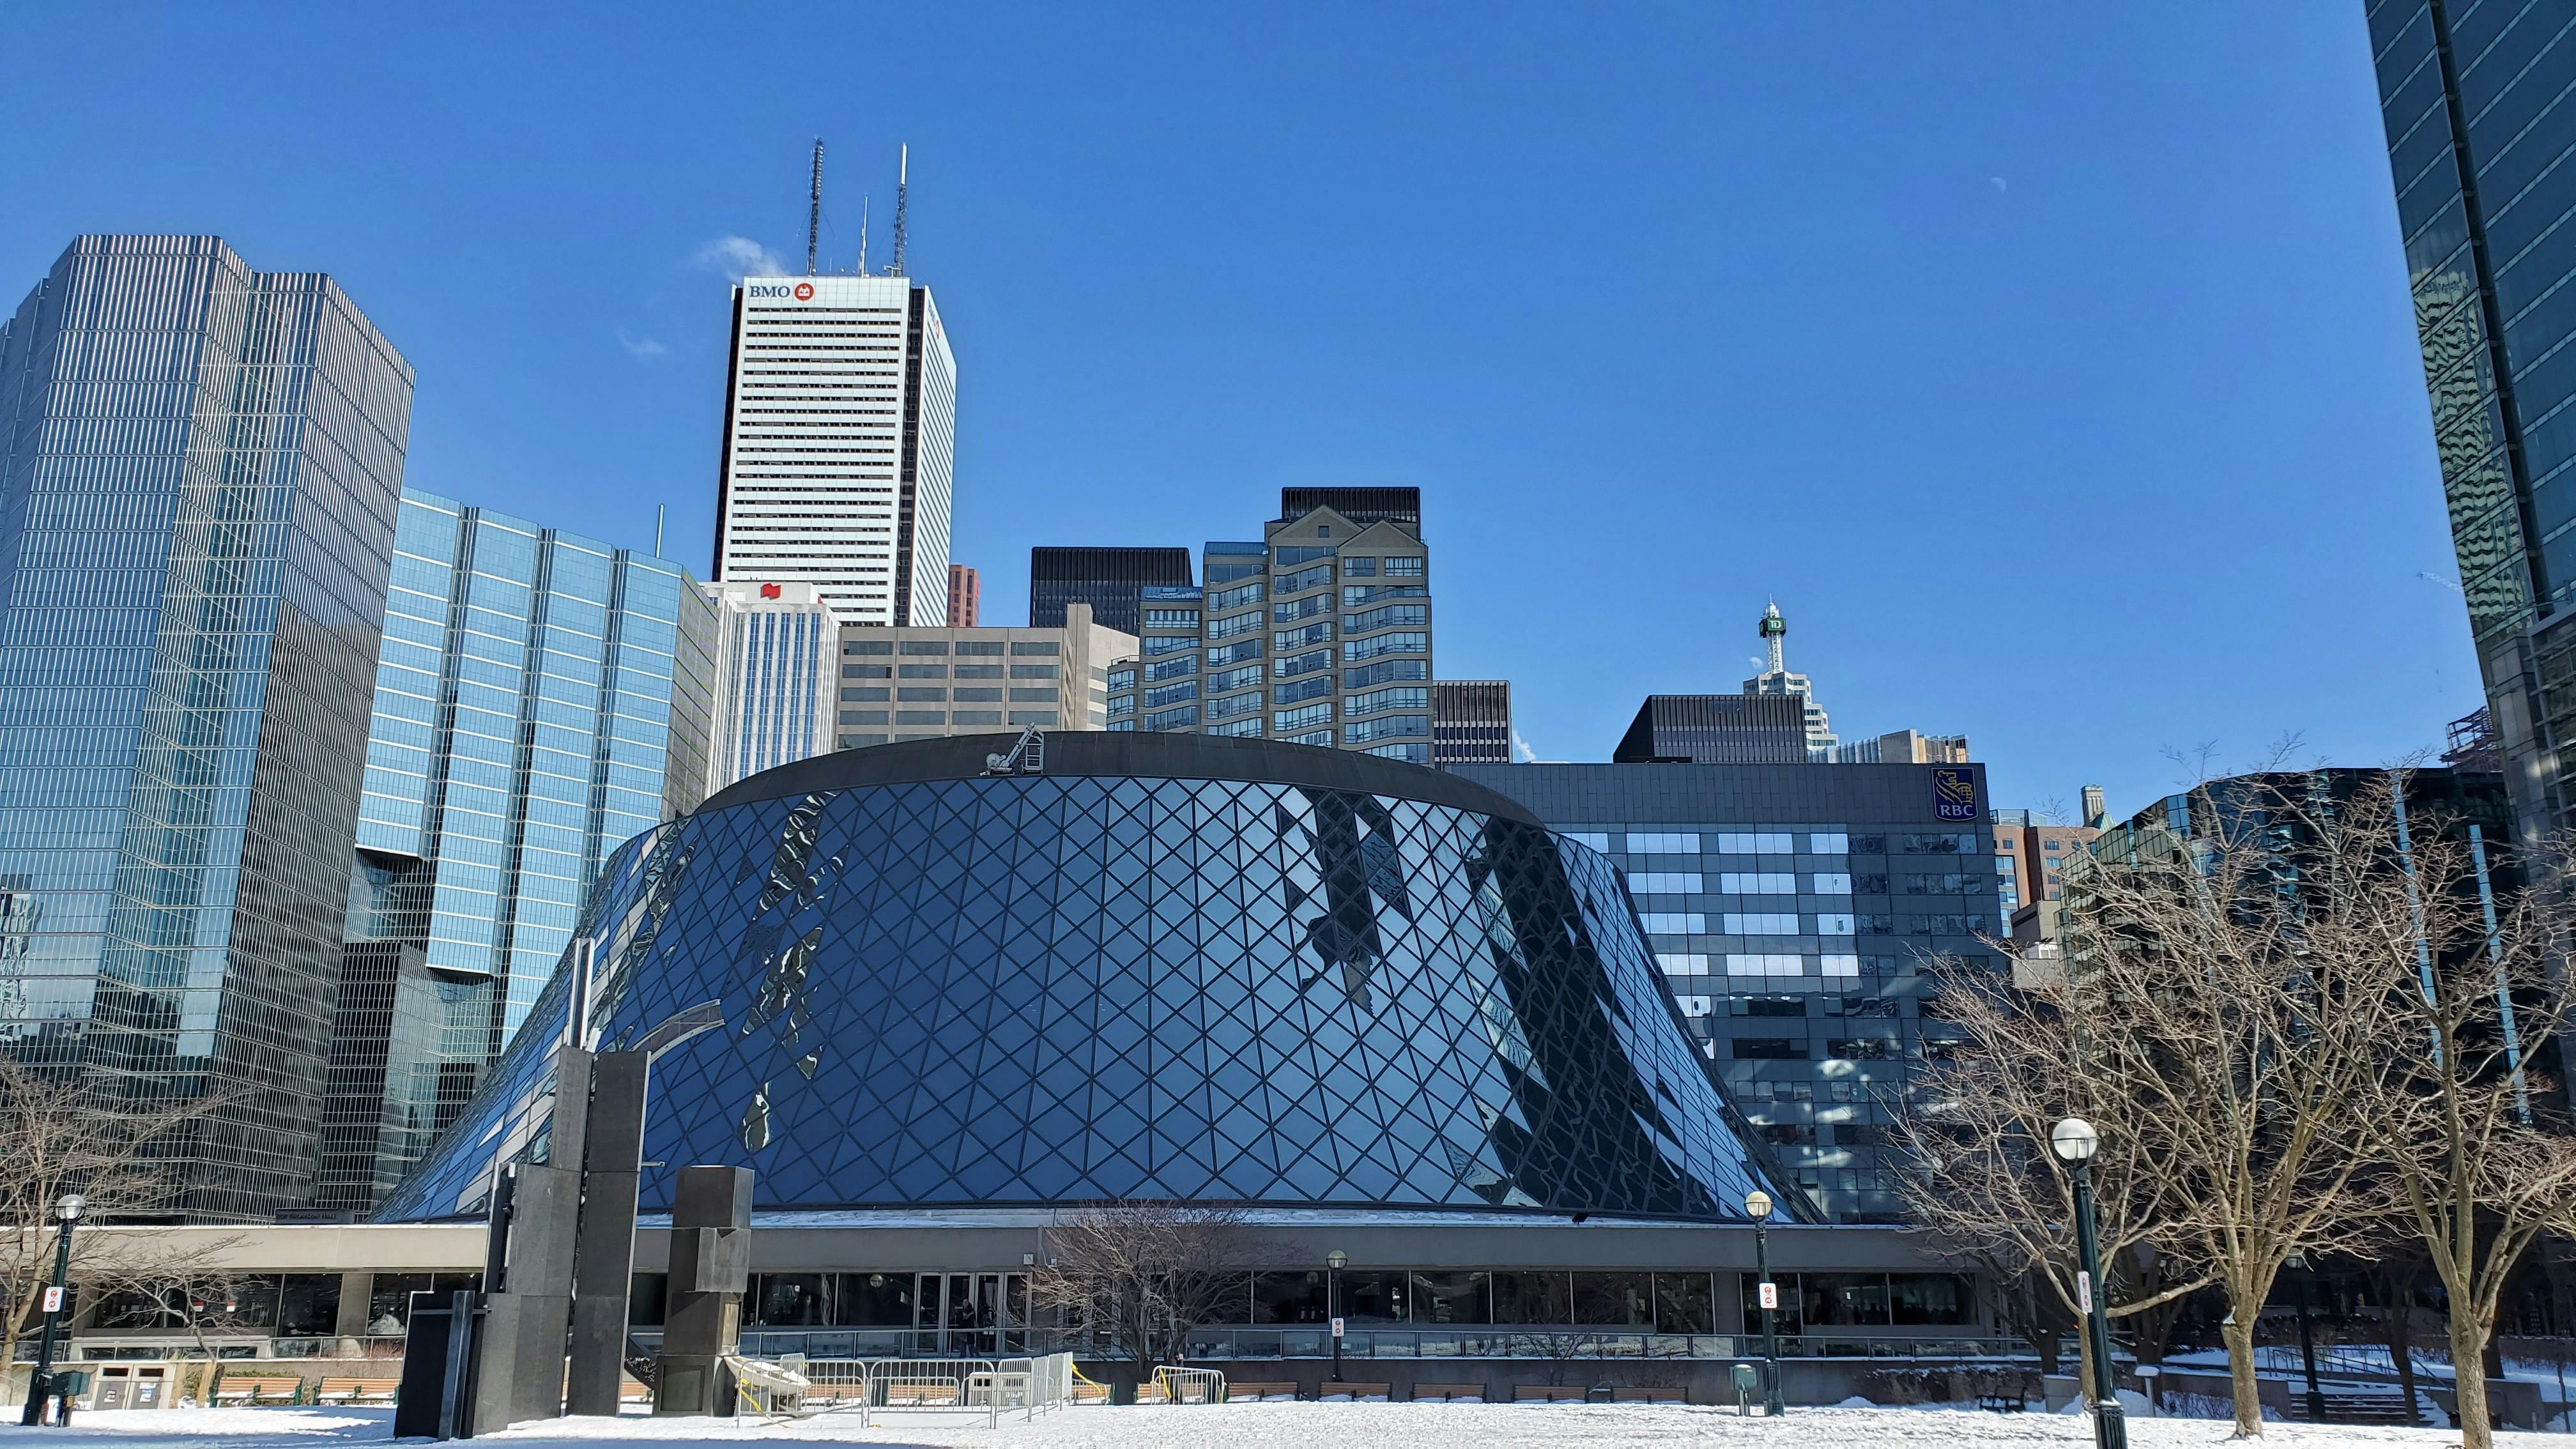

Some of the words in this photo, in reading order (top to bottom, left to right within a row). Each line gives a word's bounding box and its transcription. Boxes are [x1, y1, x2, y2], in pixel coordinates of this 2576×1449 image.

[749, 286, 791, 298] BMO
[1769, 620, 1781, 629] TD
[1940, 805, 1974, 816] RBC
